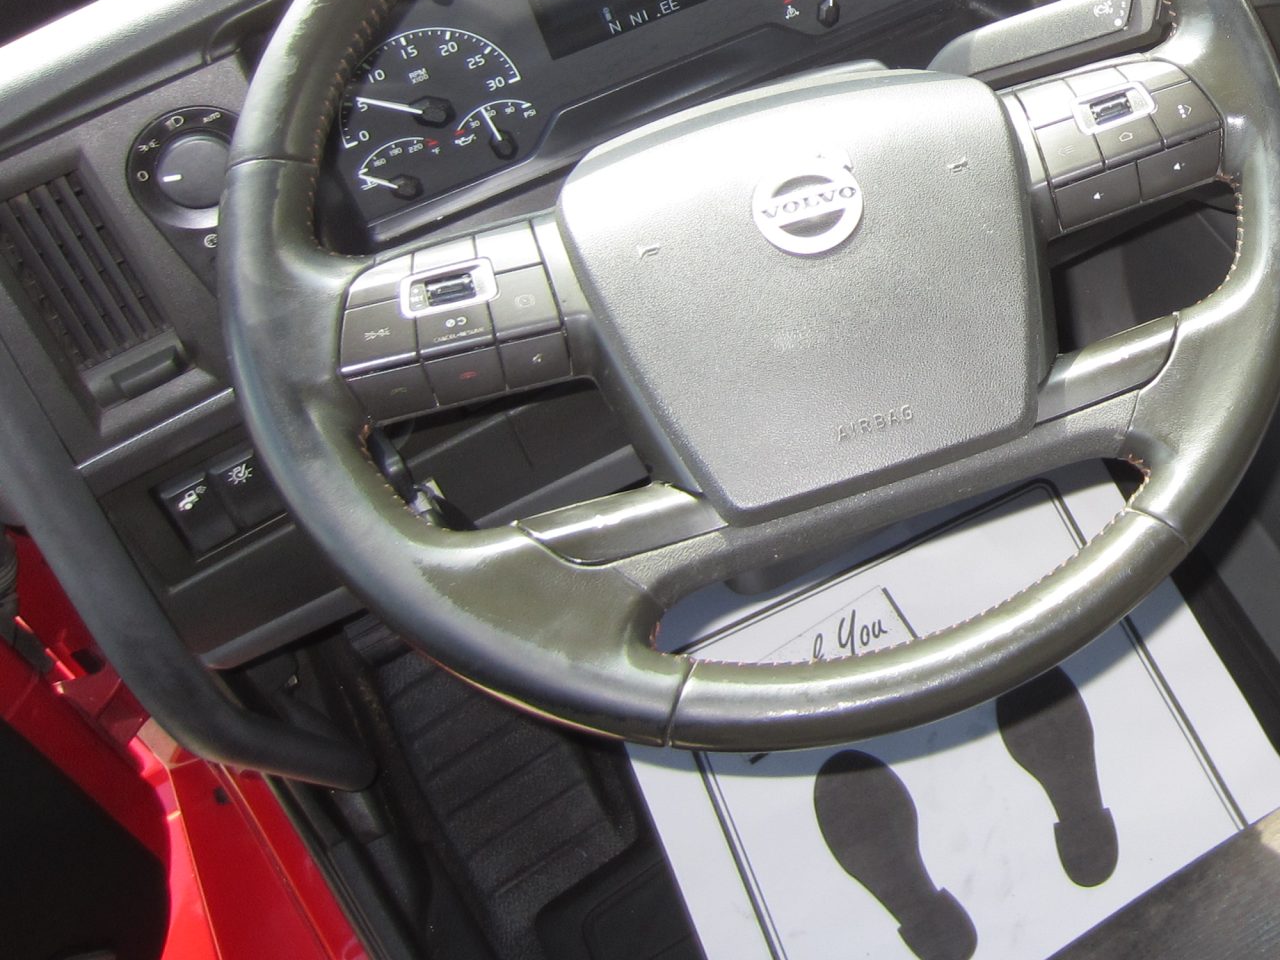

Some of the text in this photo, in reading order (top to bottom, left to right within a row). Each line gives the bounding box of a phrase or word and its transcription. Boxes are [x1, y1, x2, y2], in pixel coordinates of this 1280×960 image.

[608, 21, 622, 34] N
[401, 45, 418, 60] 15
[439, 41, 459, 57] 20
[466, 54, 486, 70] 25
[368, 69, 386, 84] 10
[486, 76, 506, 91] 30
[202, 111, 222, 124] AUTO
[358, 130, 370, 142] 0
[408, 142, 424, 154] 220
[761, 186, 857, 219] VOLVO
[838, 404, 914, 442] AIRBAG
[837, 609, 888, 656] You
